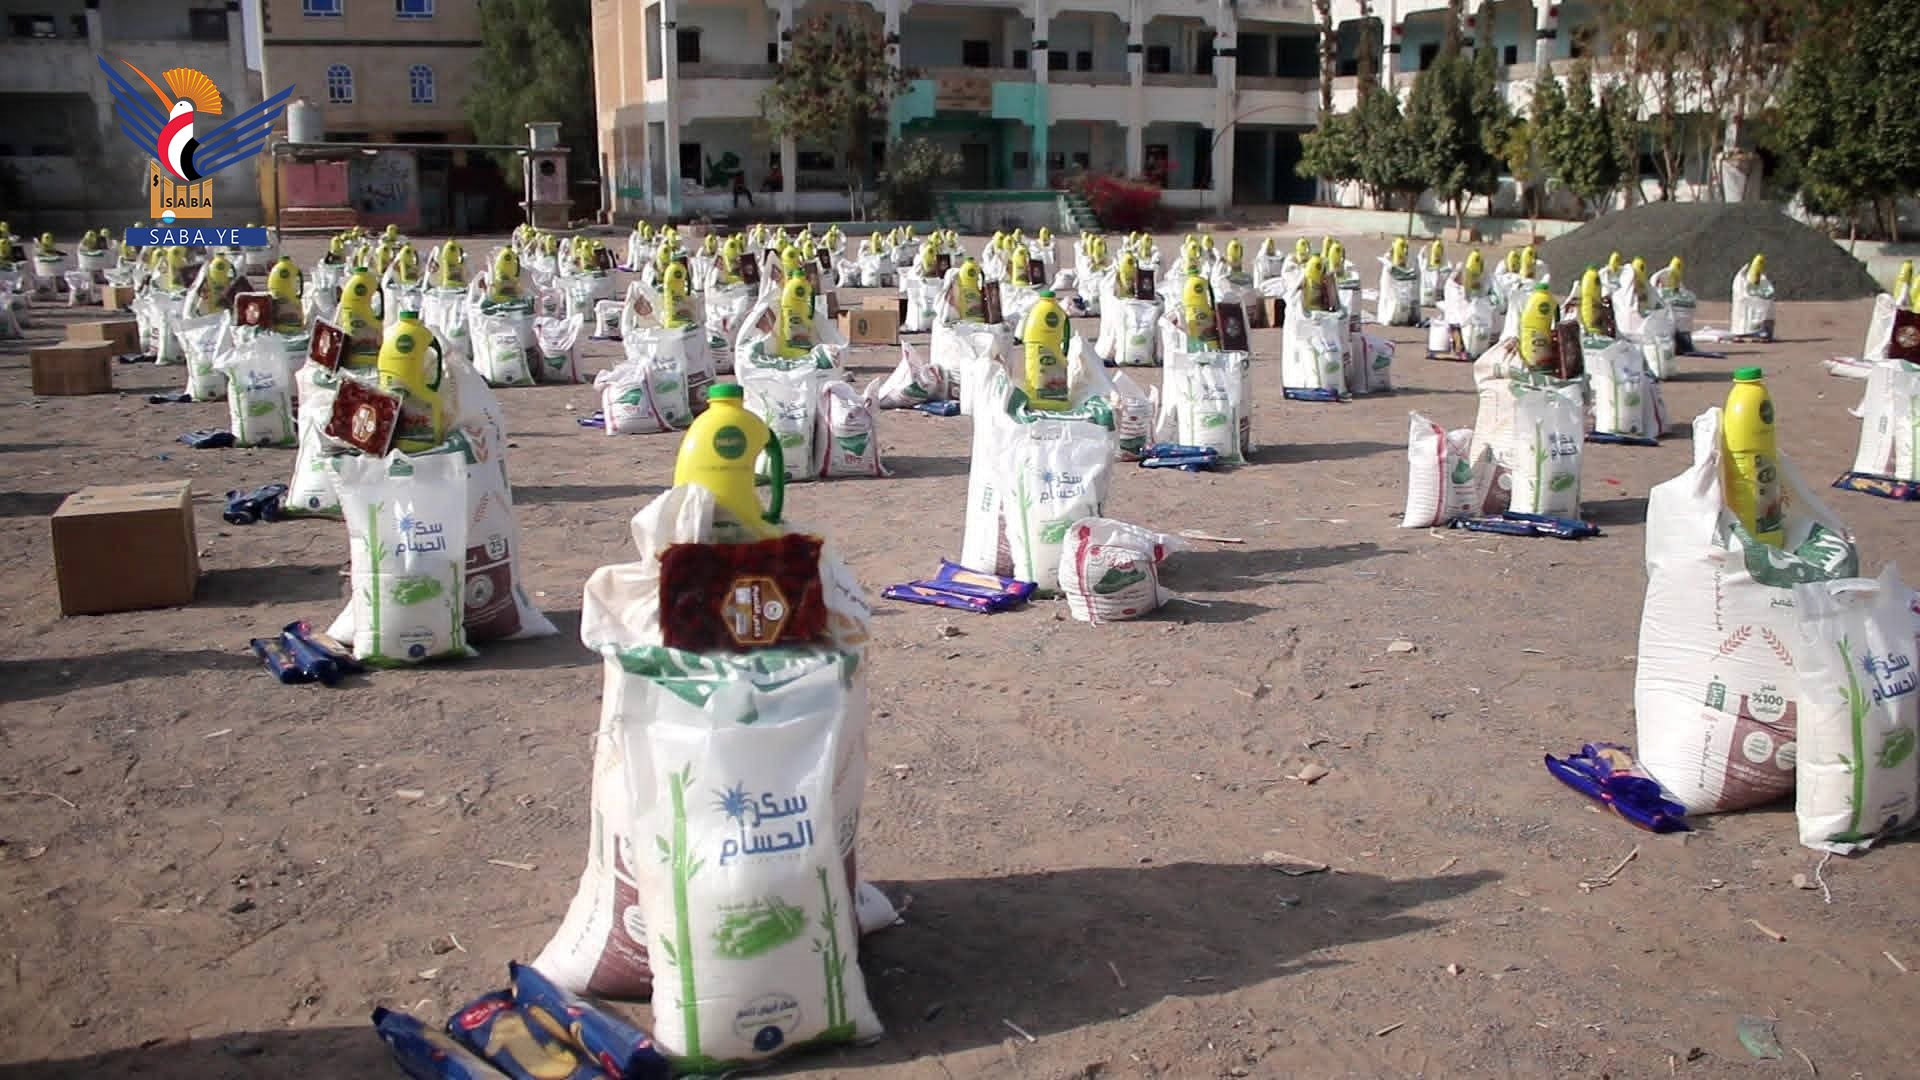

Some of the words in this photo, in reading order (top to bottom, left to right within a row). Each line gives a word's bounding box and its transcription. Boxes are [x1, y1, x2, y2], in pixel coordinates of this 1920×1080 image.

[1883, 652, 1911, 680] سكر
[752, 792, 808, 828] سكر
[719, 819, 814, 866] الحسام
